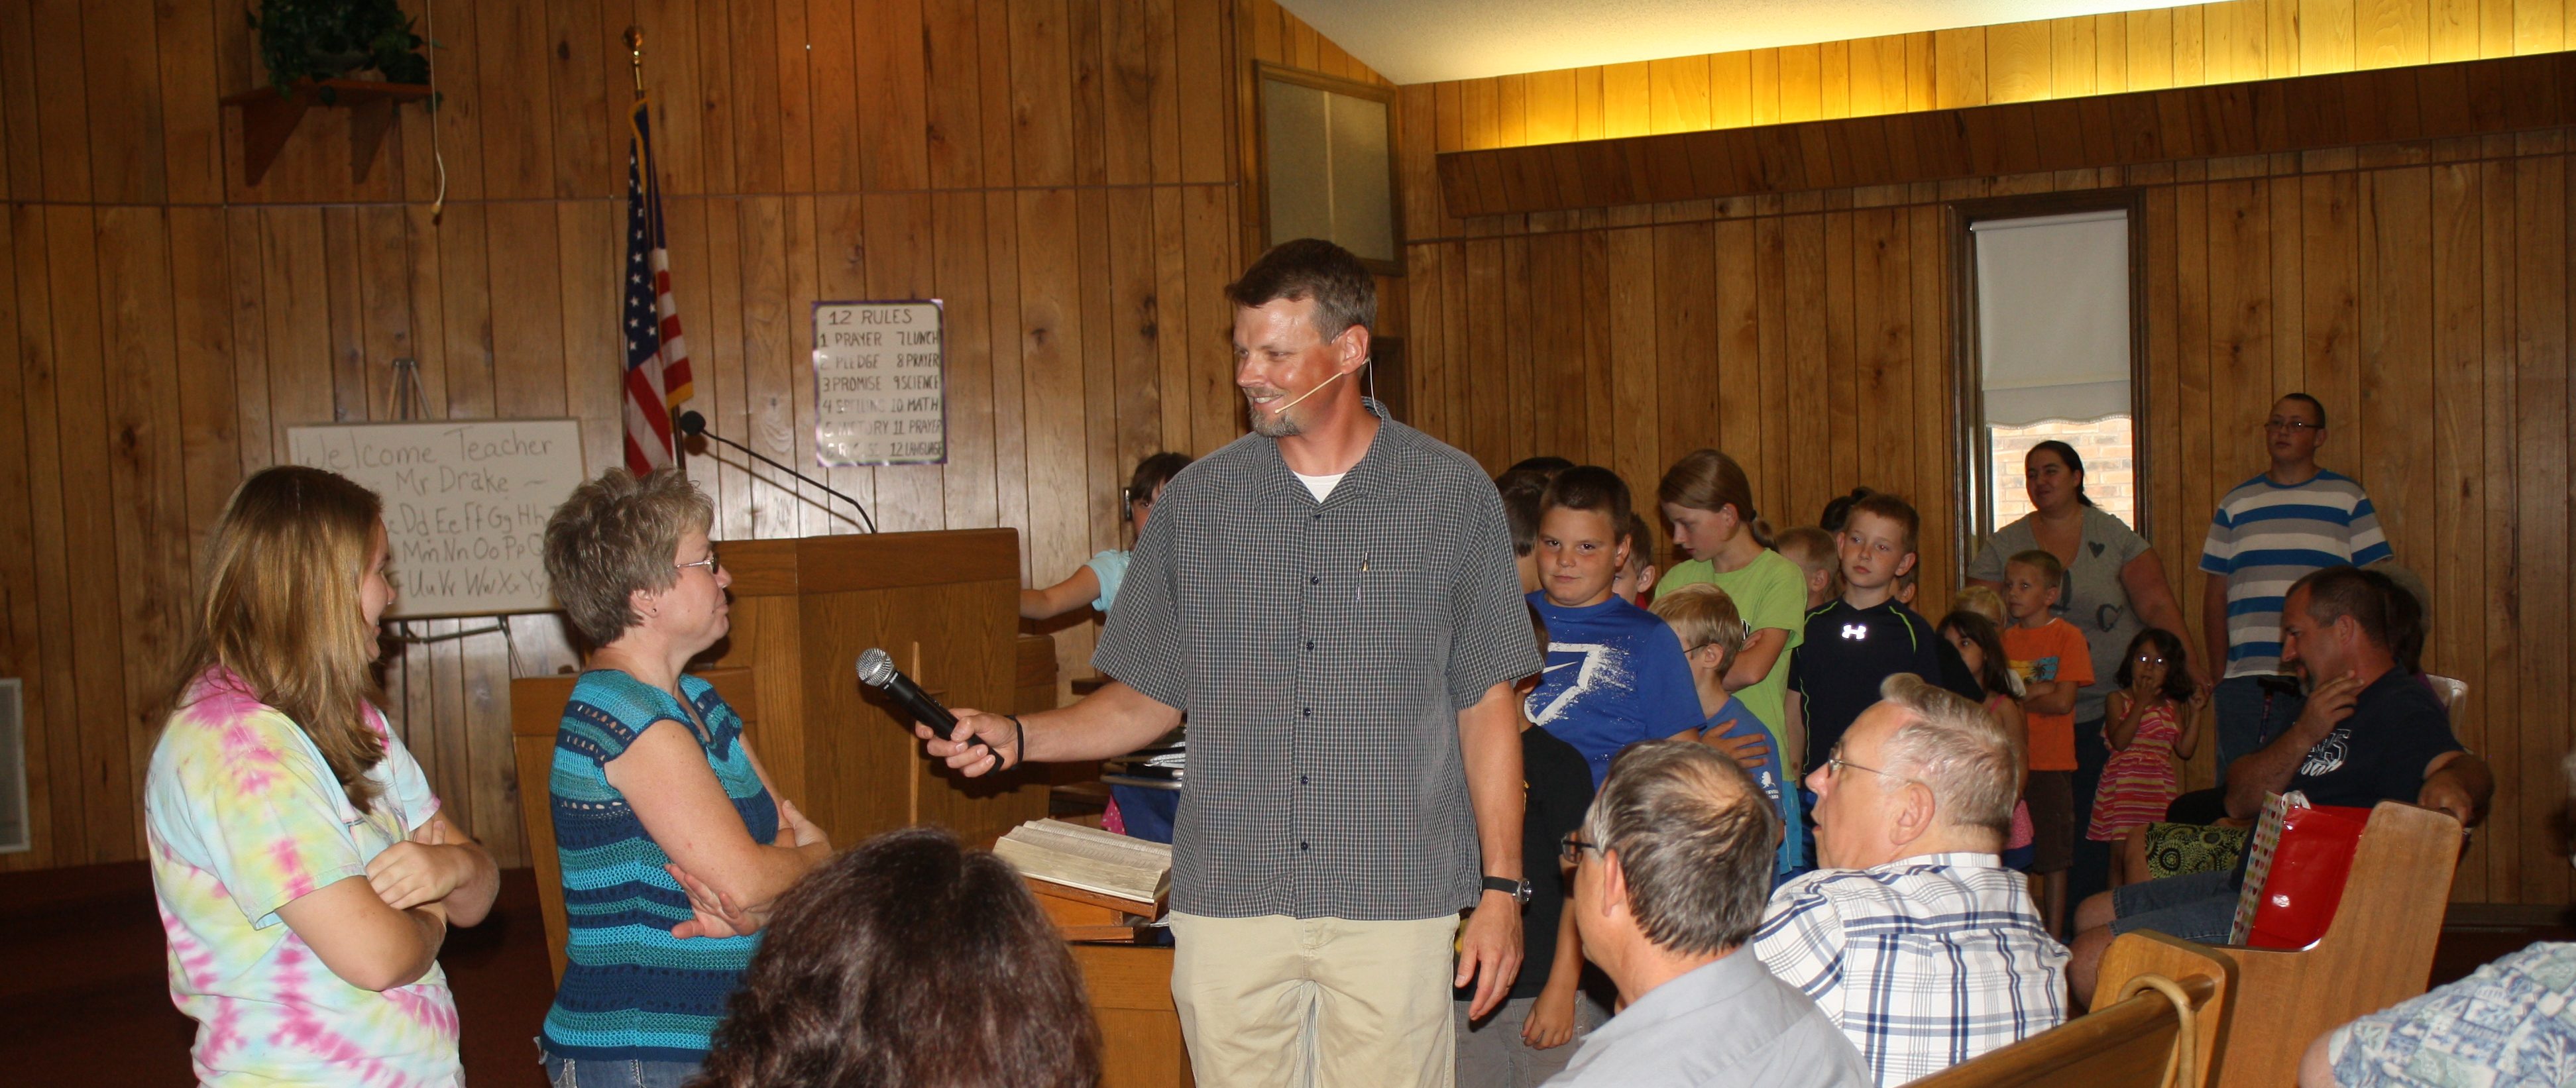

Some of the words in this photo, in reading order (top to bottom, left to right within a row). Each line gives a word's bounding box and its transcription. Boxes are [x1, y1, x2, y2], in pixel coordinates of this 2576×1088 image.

[829, 310, 852, 325] 12
[862, 309, 913, 325] RULES
[820, 333, 829, 347] 1
[835, 331, 883, 347] PRAYER
[895, 331, 905, 346] 7
[907, 331, 939, 345] LUNCH
[836, 353, 880, 369] PLEDGE
[897, 353, 905, 368] 8
[906, 353, 940, 368] PRAYER
[822, 376, 830, 392] 3
[832, 376, 881, 392] PROMISE
[893, 374, 901, 390] 9
[901, 374, 939, 390] SCIENCE
[822, 399, 832, 414] 4
[891, 398, 904, 413] 10
[907, 396, 939, 412] MATH
[893, 419, 905, 435] 11
[296, 429, 437, 470] Welcome
[443, 426, 553, 462] Teacher
[889, 441, 904, 457] 12
[395, 467, 428, 496] Mr
[439, 464, 510, 493] Drake
[399, 502, 429, 537] Dd
